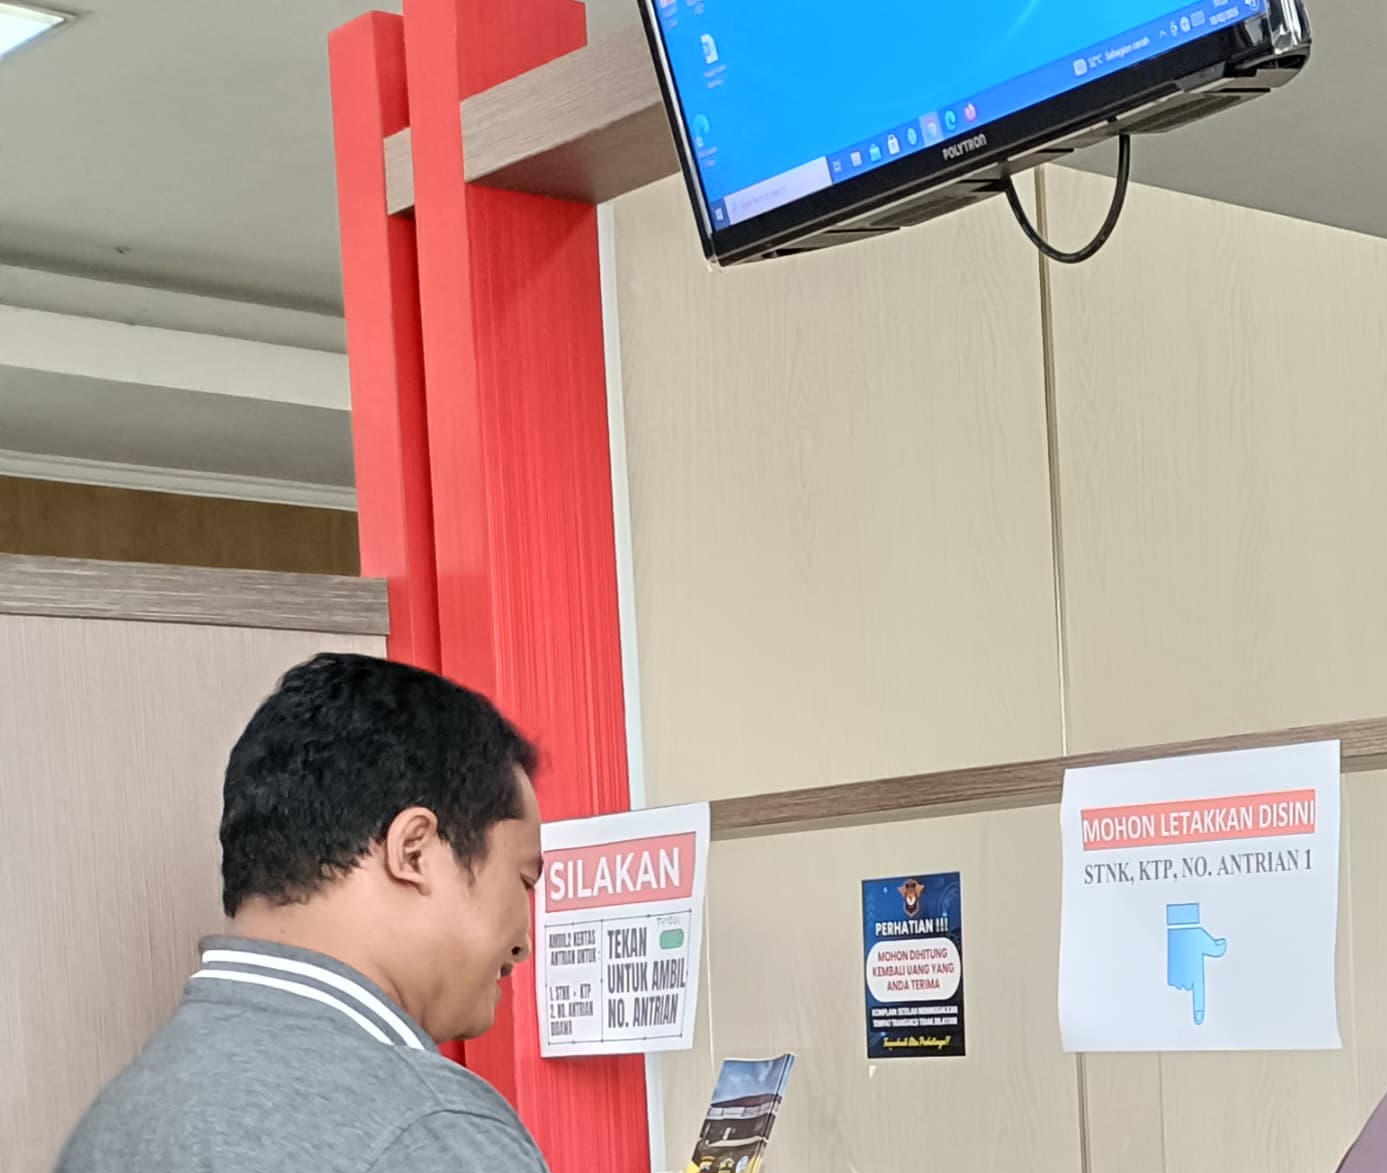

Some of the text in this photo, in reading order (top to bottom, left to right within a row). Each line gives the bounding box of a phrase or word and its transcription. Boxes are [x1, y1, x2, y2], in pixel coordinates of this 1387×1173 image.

[942, 133, 987, 161] POLYTRON
[1083, 799, 1315, 842] MOHON LETAKKAN DISINI
[550, 847, 680, 901] SILAKAN
[1085, 848, 1312, 885] STNK, KTP, NO. ANTRIAN 1
[607, 926, 647, 959] TEKAN
[875, 918, 934, 937] PERHATIAN
[877, 947, 949, 963] MOHON DIHITUNG
[906, 962, 931, 976] UANG
[931, 961, 956, 975] YANG
[607, 957, 686, 994] UNTUK AMBIL
[886, 978, 941, 992] ANDA TERIMA
[608, 993, 679, 1029] NO. ANTRIAN
